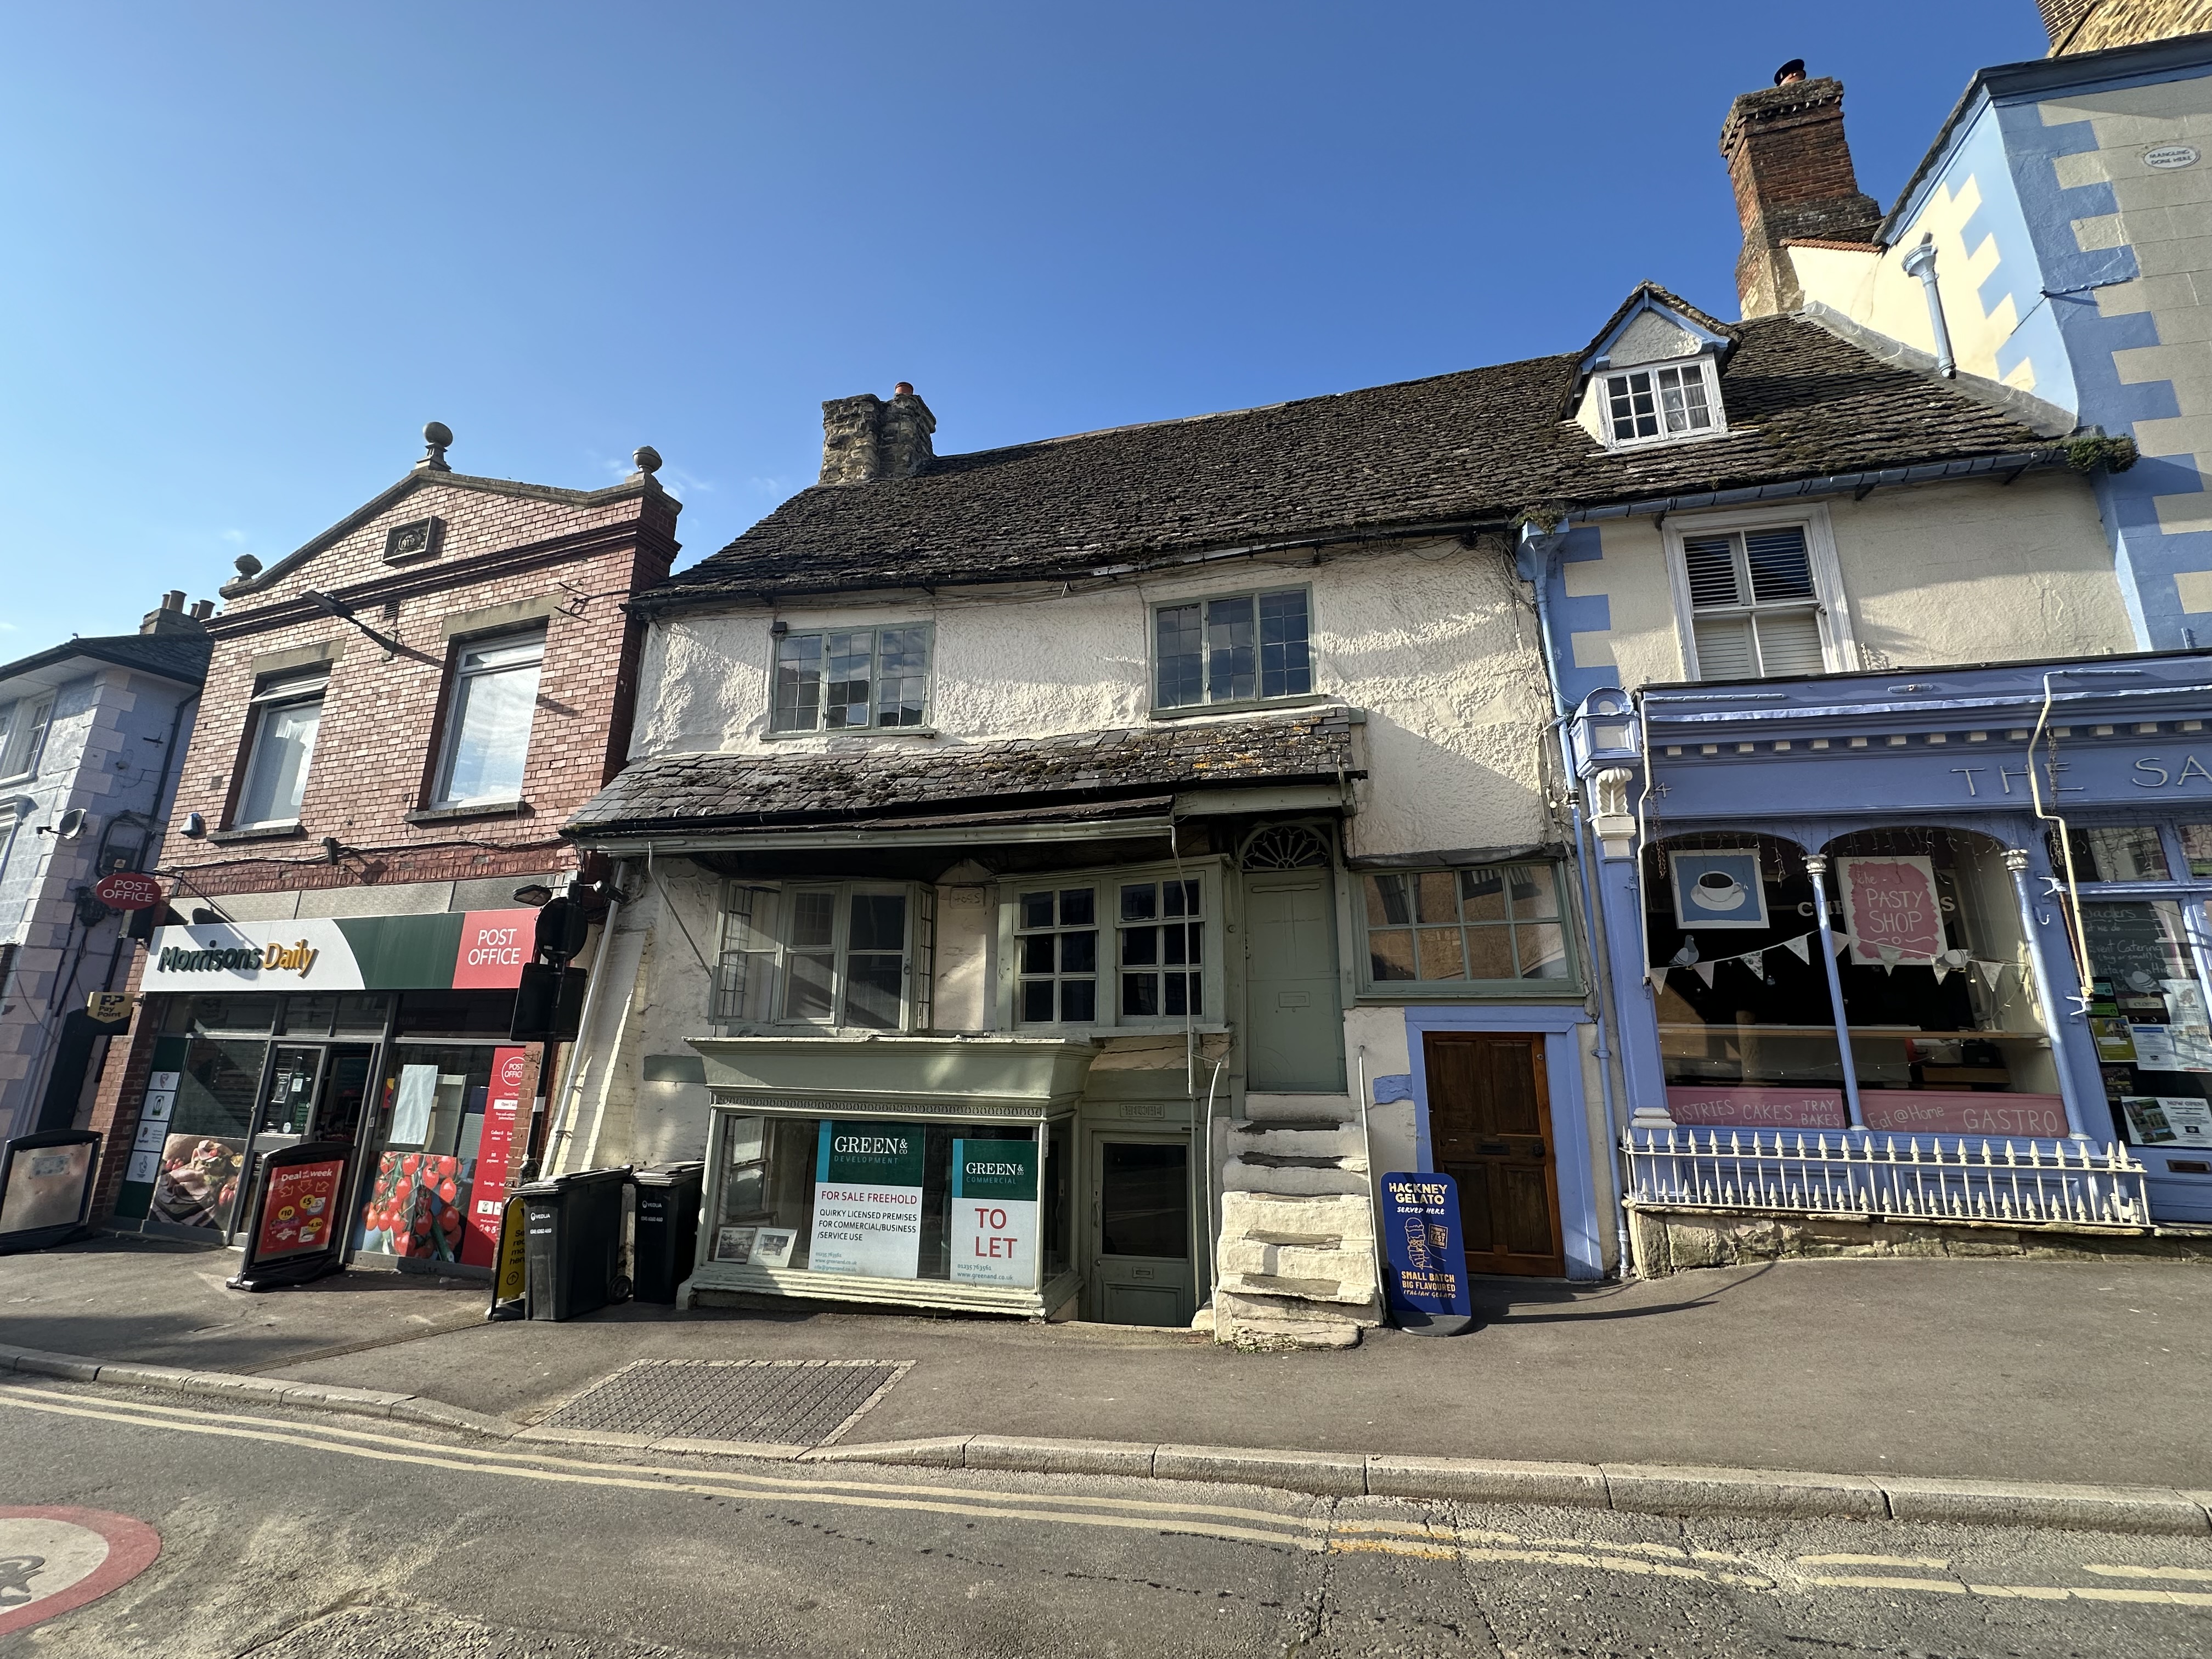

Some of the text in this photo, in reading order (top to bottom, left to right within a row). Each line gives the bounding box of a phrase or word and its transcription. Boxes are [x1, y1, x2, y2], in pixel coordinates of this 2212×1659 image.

[1951, 762, 2084, 796] THE
[114, 880, 151, 891] POST
[103, 889, 154, 902] OFFICE
[1866, 889, 1922, 908] PASTY
[1869, 910, 1922, 933] SHOP
[477, 928, 517, 945] POST
[2086, 939, 2165, 959] Event Catering
[157, 939, 319, 979] Morrisons Daily
[468, 947, 521, 965] OFFICE
[1743, 1104, 1792, 1120] CAKES
[1802, 1100, 1834, 1111] TRAY
[1801, 1114, 1840, 1126] BAKES
[1867, 1111, 1891, 1130] Eat
[1963, 1108, 2058, 1132] GASTRO
[834, 1136, 908, 1155] GREEN &
[834, 1155, 899, 1164] DEVELOPMENT
[310, 1169, 333, 1177] week
[966, 1163, 1017, 1176] GREEN
[281, 1171, 302, 1182] Deal
[966, 1176, 1017, 1184] COMMERCIAL
[1389, 1182, 1448, 1195] HACKNEY
[821, 1190, 917, 1204] FOR SALE FREEHOLD
[1395, 1193, 1444, 1205] GELATO
[281, 1209, 292, 1217] £10
[820, 1209, 917, 1221] QUIRKY LICENSED PREMISES
[974, 1208, 1007, 1229] TO
[819, 1220, 916, 1233] FOR COMMERCIAL/BUSINESS
[817, 1231, 848, 1240] /SERVICE
[975, 1236, 1018, 1259] LET
[957, 1272, 1013, 1281] www.greenand.co.uk
[1401, 1271, 1455, 1283] SMALL BATCH
[1402, 1280, 1456, 1292] BIG FLAVOURED
